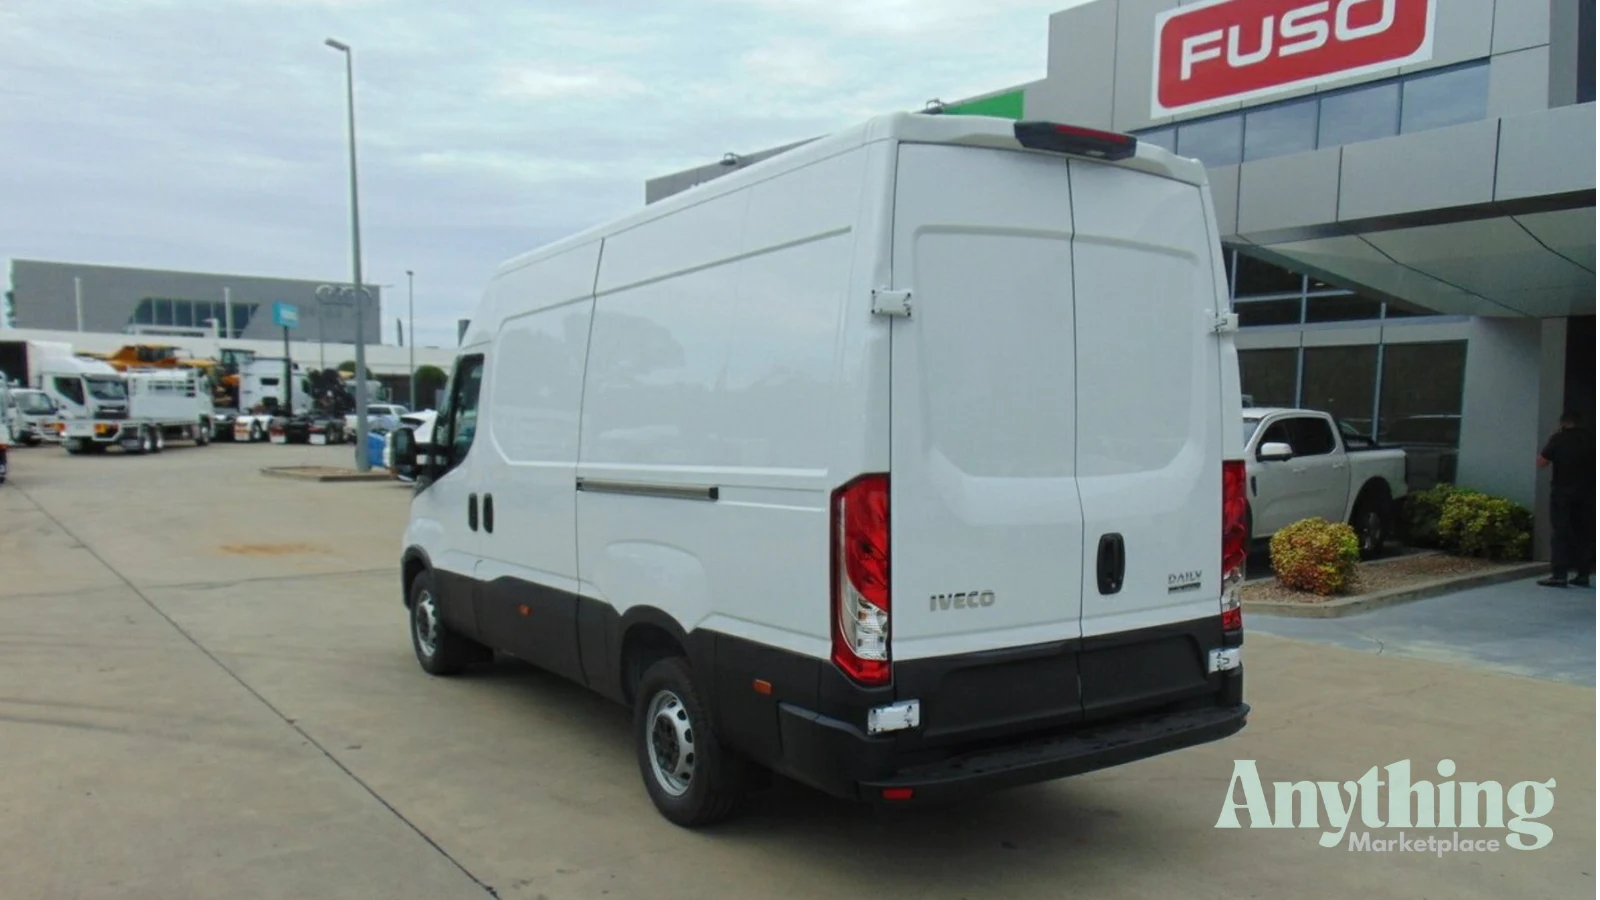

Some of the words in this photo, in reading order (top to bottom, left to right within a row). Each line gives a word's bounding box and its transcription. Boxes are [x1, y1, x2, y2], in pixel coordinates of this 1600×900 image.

[1180, 0, 1396, 81] FUSO
[1167, 570, 1203, 584] DAILY
[929, 589, 996, 612] IVECO
